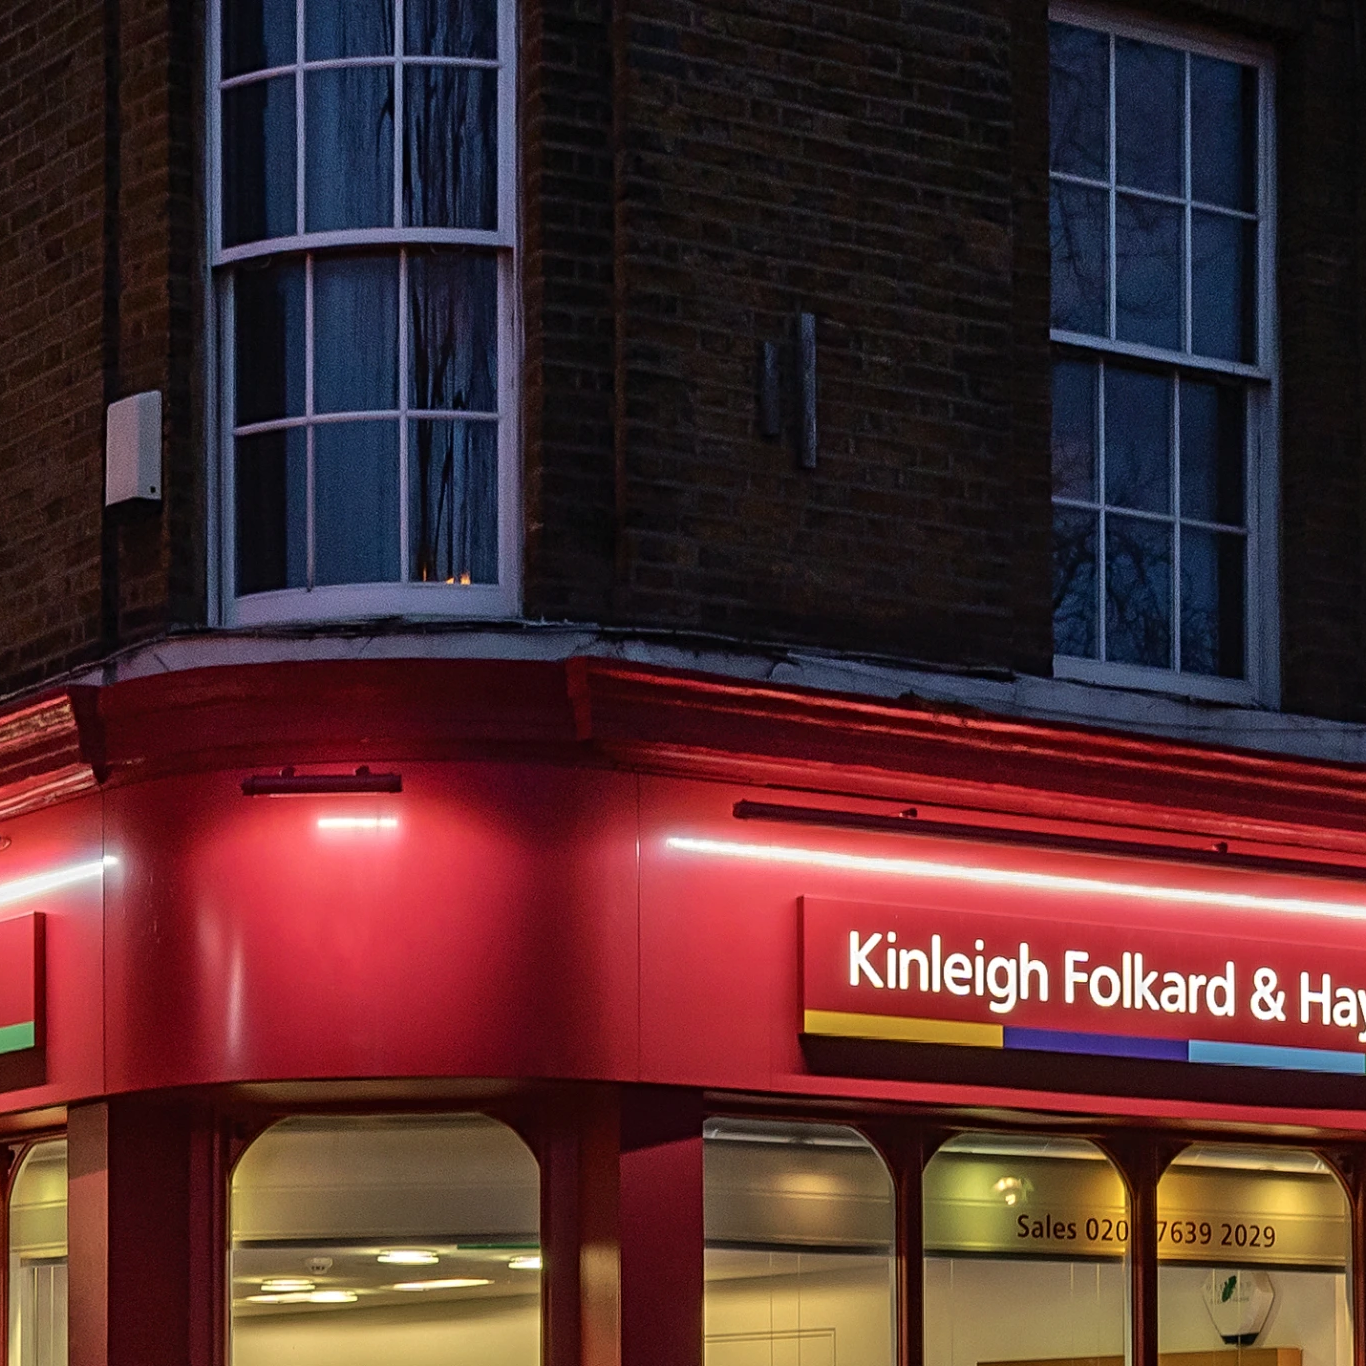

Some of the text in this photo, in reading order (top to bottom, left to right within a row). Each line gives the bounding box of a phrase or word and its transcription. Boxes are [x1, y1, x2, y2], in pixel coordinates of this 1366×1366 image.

[848, 929, 1049, 1014] Kinleigh
[1064, 949, 1236, 1017] Folkard
[1250, 966, 1286, 1022] &
[1017, 1213, 1277, 1248] Sales 020 7639 2029
